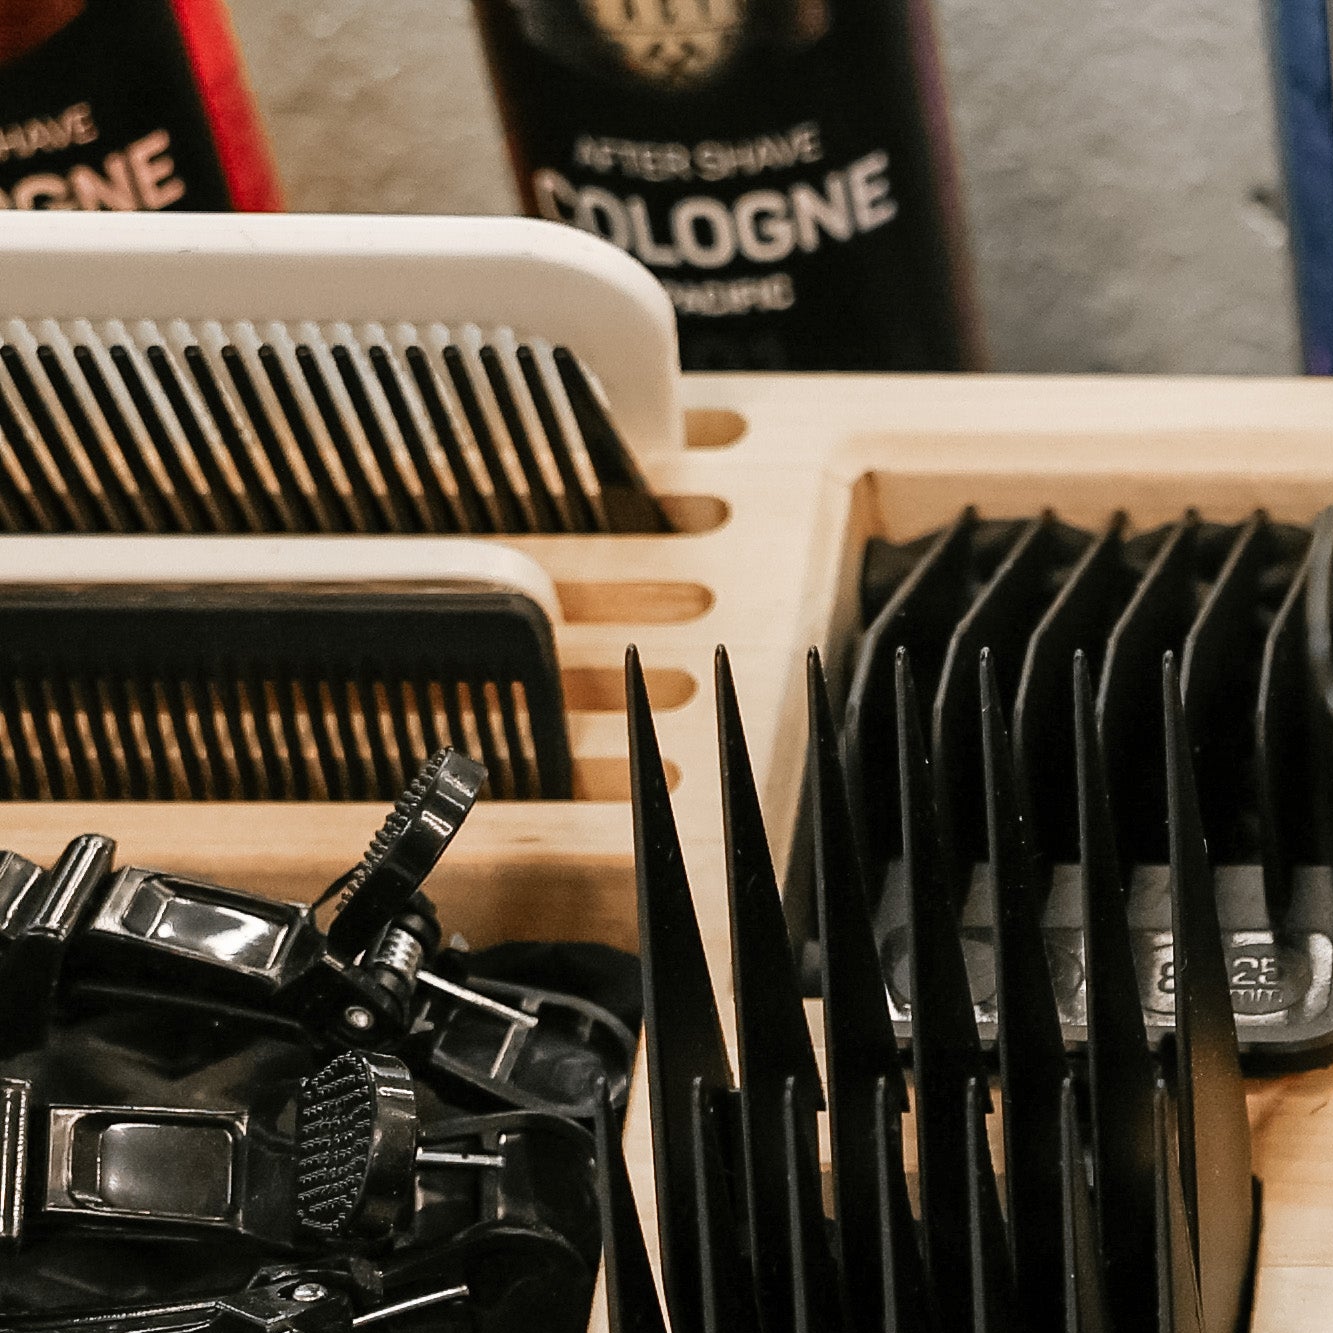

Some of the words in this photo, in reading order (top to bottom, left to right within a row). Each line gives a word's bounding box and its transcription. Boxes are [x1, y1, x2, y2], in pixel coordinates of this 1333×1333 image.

[575, 134, 693, 181] AFTER
[693, 121, 821, 181] SHAVE
[1231, 956, 1280, 985] 25
